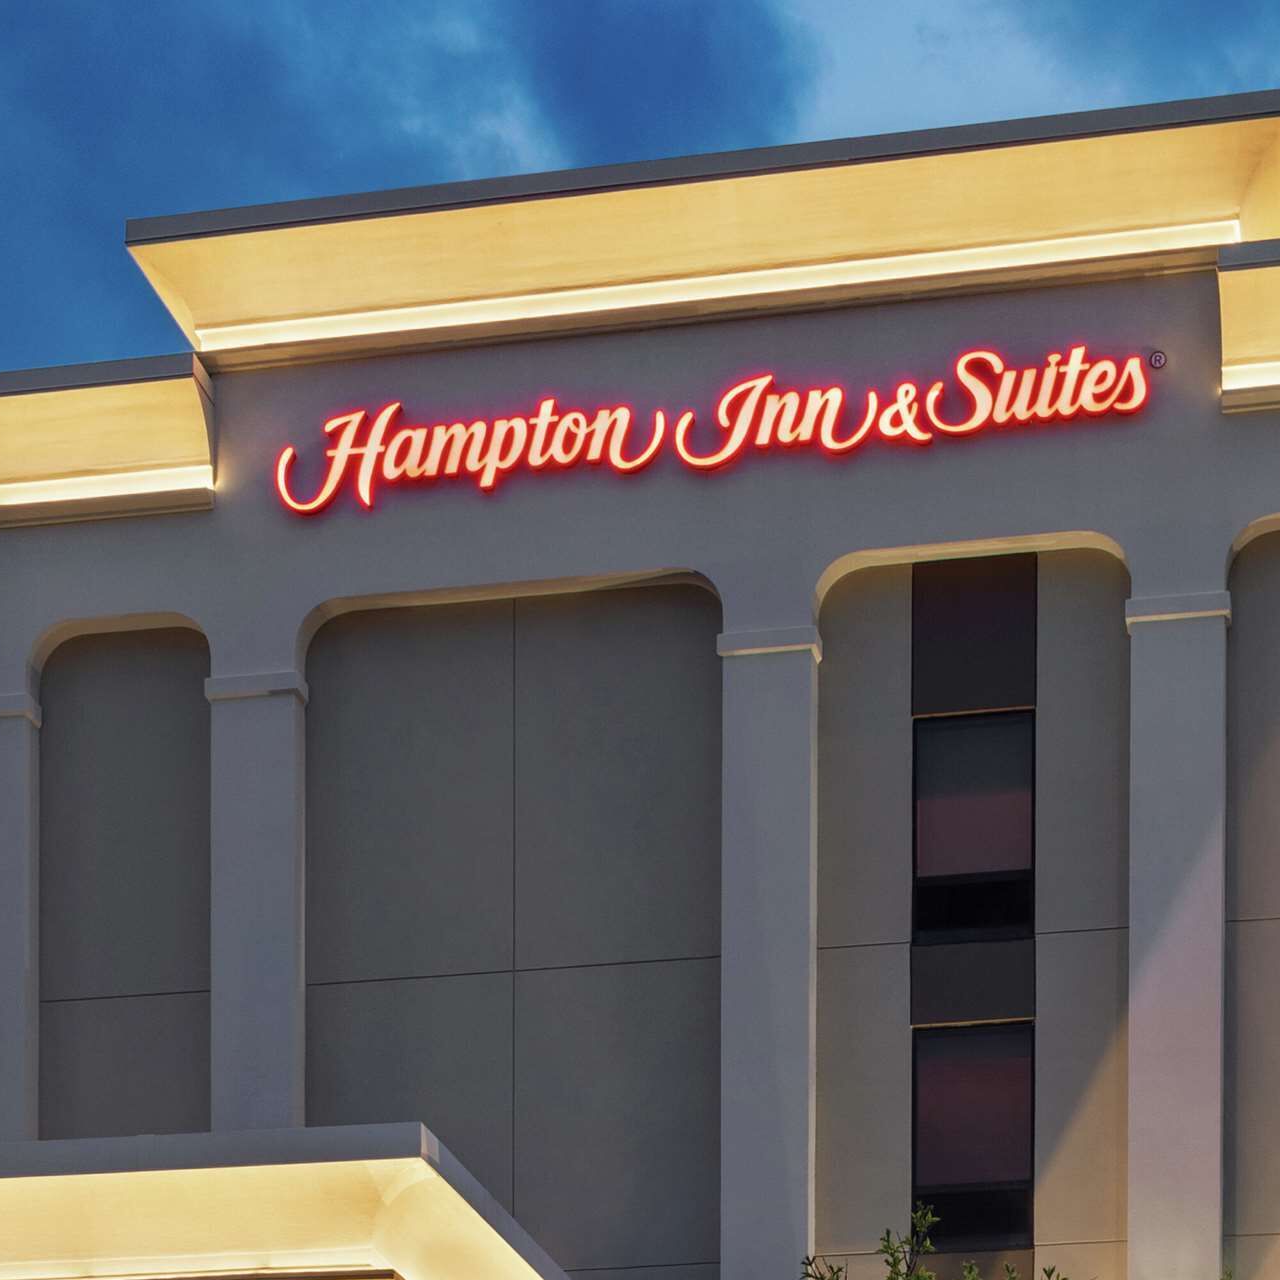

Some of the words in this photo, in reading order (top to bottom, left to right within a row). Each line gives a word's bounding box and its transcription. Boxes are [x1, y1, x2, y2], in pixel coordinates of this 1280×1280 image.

[276, 398, 665, 513] Hampton
[674, 374, 878, 467] Inn
[878, 382, 933, 443] &
[925, 345, 1148, 435] Suites
